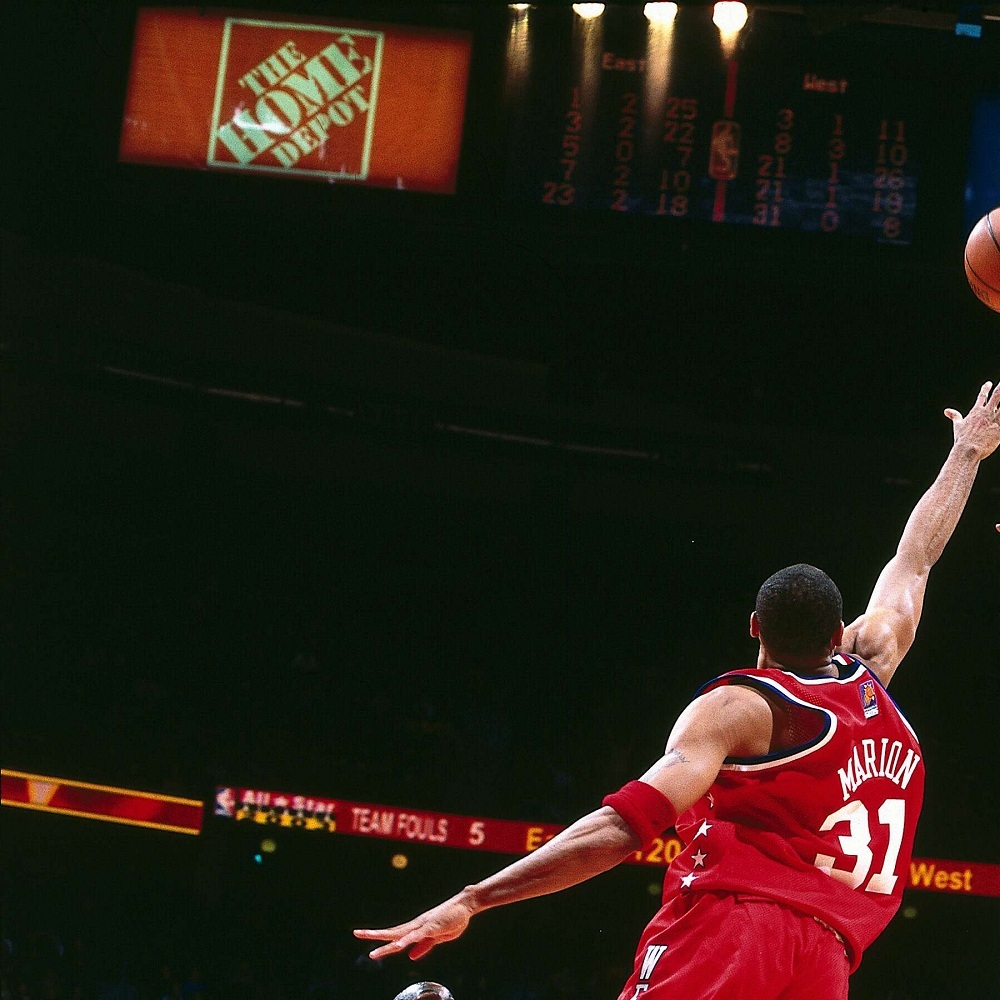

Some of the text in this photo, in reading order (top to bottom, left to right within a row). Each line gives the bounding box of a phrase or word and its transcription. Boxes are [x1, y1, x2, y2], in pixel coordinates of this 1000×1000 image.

[238, 41, 307, 97] THE
[602, 52, 646, 74] East
[216, 34, 373, 164] HOME
[802, 73, 848, 94] West
[271, 85, 370, 168] DEPOT
[565, 110, 695, 144] 3 2 22
[776, 107, 906, 143] 3 1 11
[615, 140, 634, 162] 0
[676, 145, 692, 167] 7
[774, 131, 908, 167] 8 3 10
[560, 159, 577, 181] 7
[659, 169, 691, 193] 10
[757, 154, 787, 180] 21
[827, 162, 840, 184] 1
[542, 181, 688, 217] 23 2 18
[754, 177, 784, 202] 21
[825, 185, 837, 208] 1
[752, 201, 782, 227] 31
[820, 209, 840, 232] 0
[837, 737, 921, 802] MARION
[351, 806, 394, 836] TEAM
[397, 813, 449, 842] FOULS
[468, 821, 486, 846] 5
[814, 798, 906, 896] 31
[909, 862, 973, 891] West
